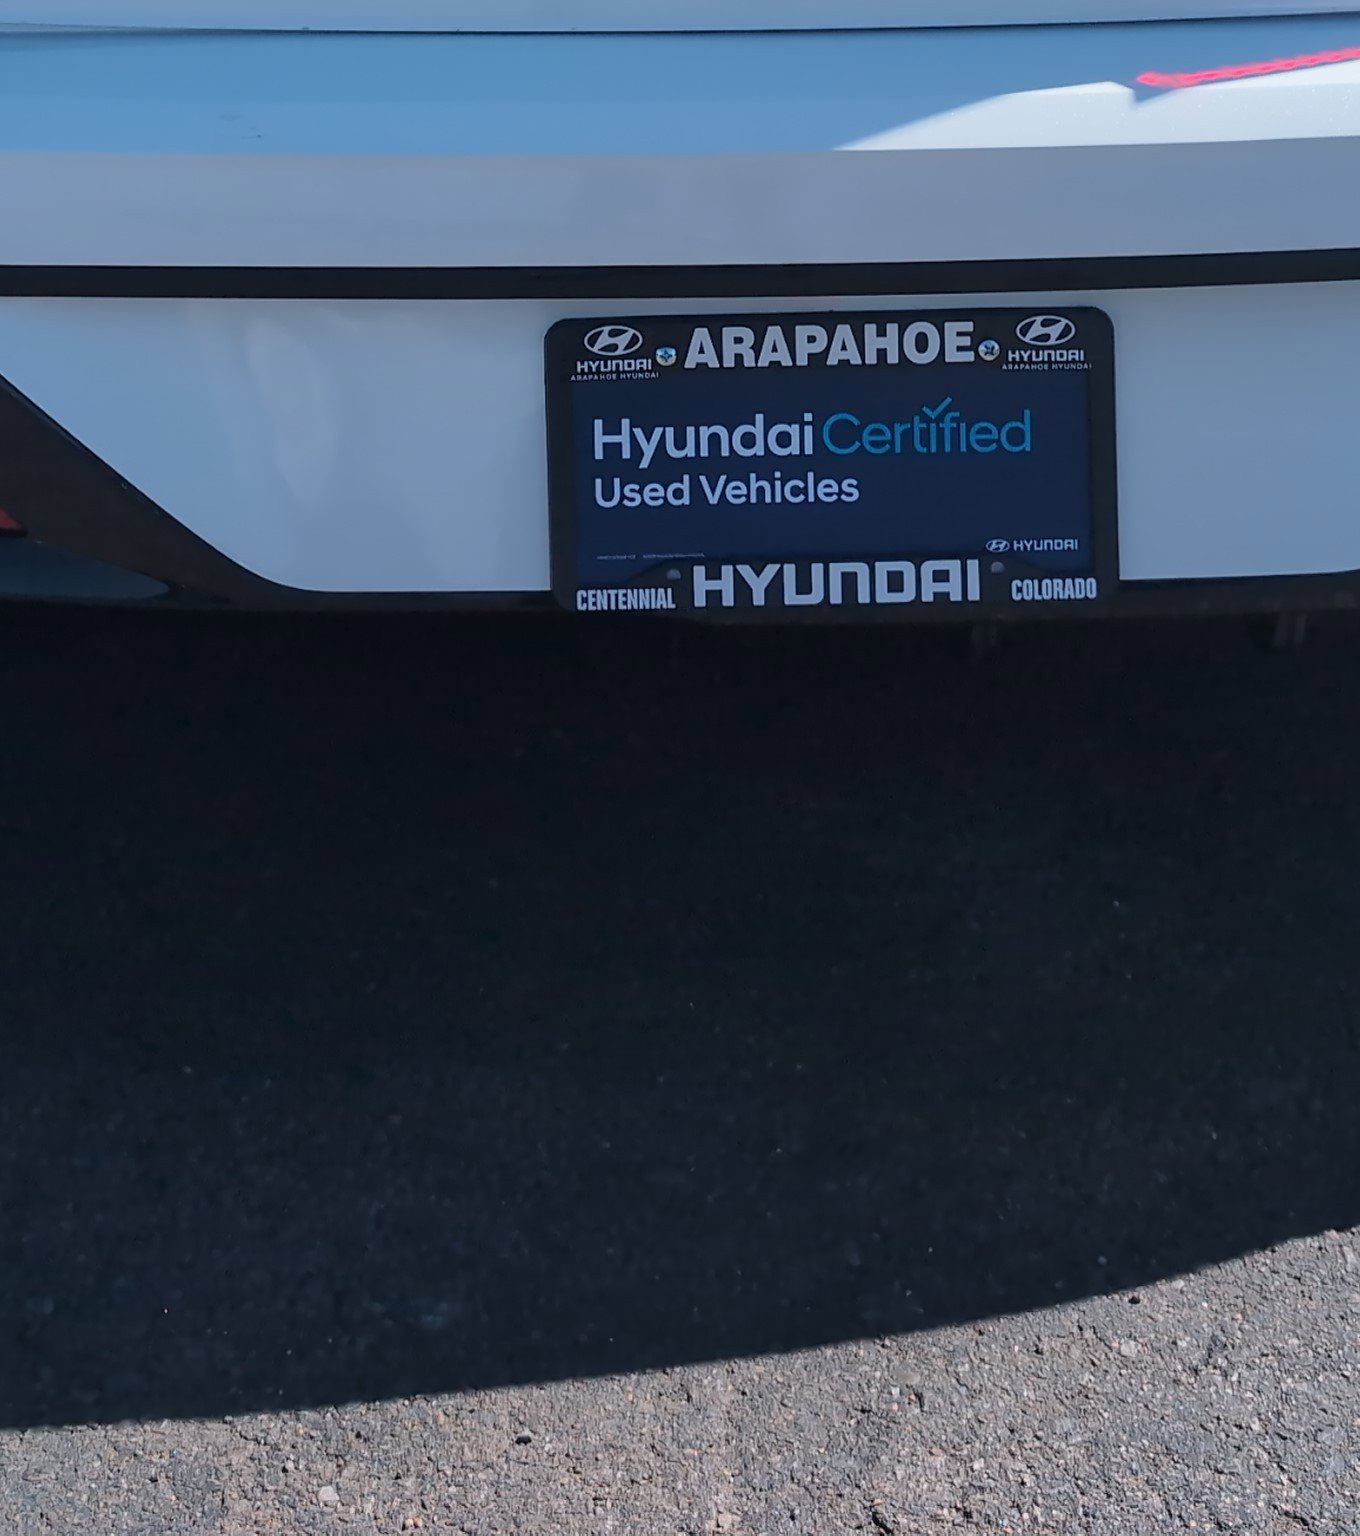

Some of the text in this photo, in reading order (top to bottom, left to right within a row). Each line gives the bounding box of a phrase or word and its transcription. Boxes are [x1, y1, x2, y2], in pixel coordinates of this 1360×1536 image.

[684, 321, 975, 368] ARAPAHOE
[1008, 349, 1085, 362] HYUNDAI
[570, 371, 659, 381] ARAPAHOE HYUNDAI
[576, 358, 652, 373] HYUNDAI
[1001, 363, 1049, 371] ARAPAHOE
[593, 396, 1032, 469] Hyundai Certified
[594, 471, 860, 508] Used Vehicles
[1013, 539, 1078, 551] HYUNDAI
[693, 559, 980, 608] HYUNDAI
[1011, 577, 1097, 601] COLORADO
[576, 587, 676, 611] CENTENNIAL
